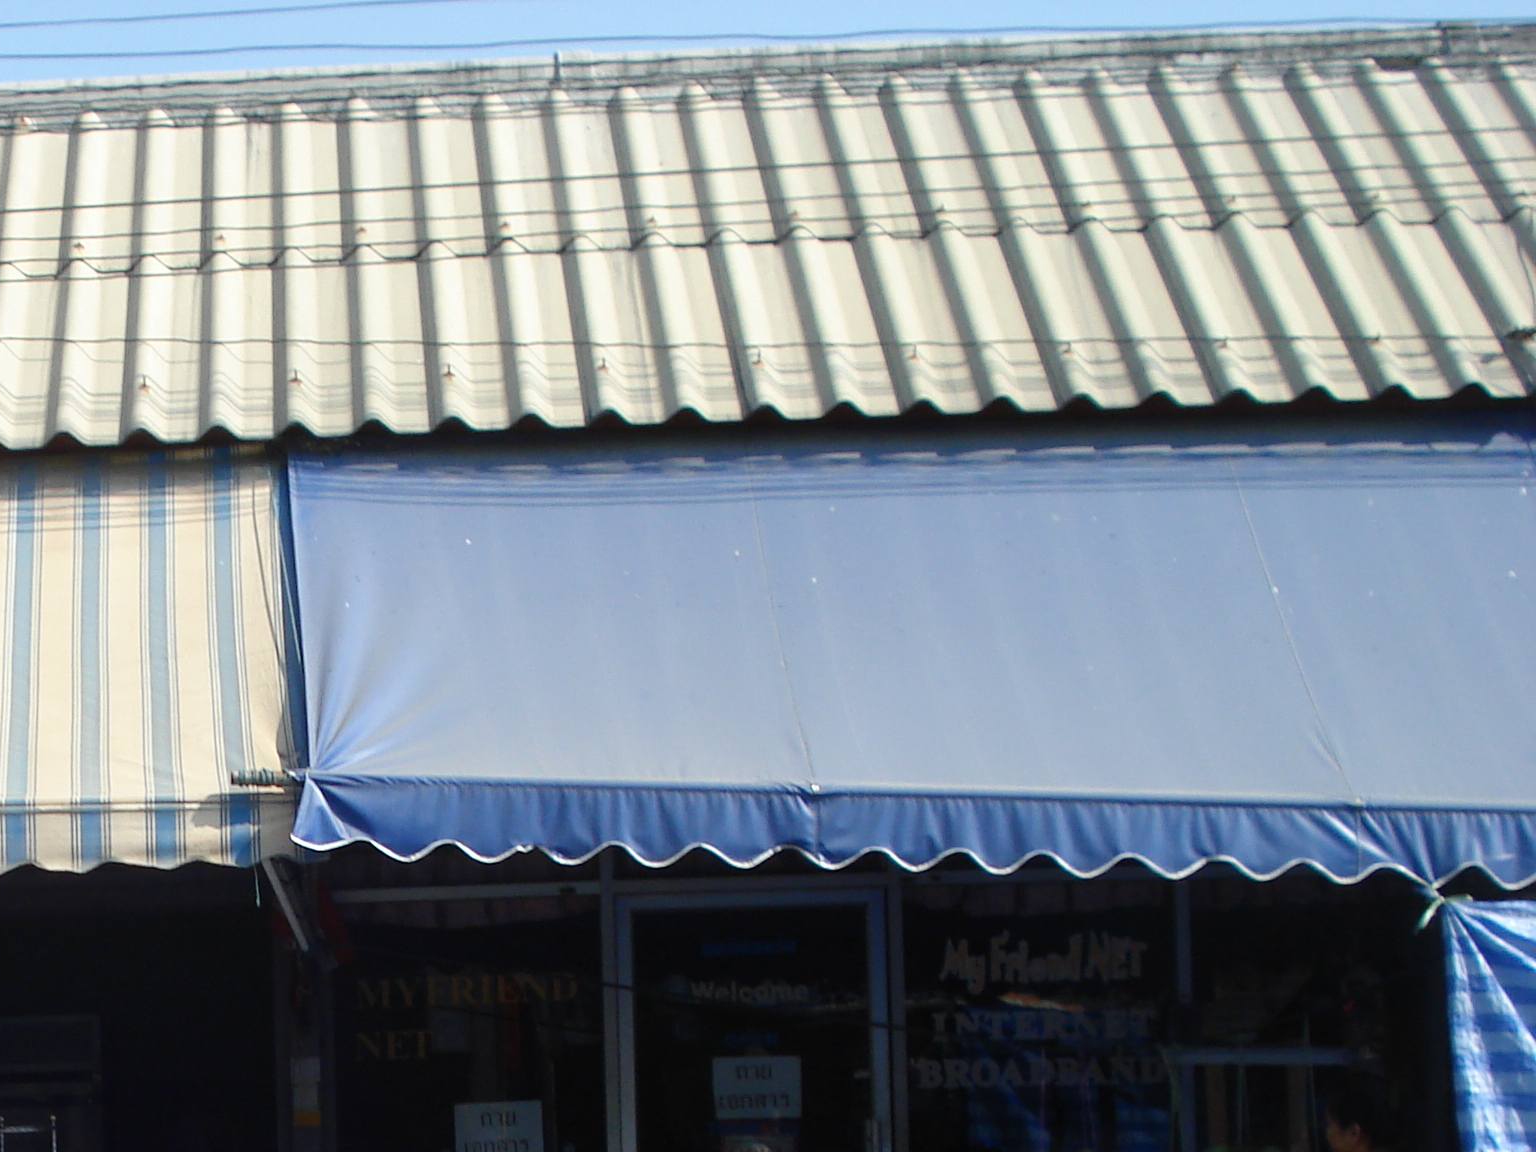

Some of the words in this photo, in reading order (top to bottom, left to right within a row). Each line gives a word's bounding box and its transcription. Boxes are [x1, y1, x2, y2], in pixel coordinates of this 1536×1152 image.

[690, 979, 810, 1004] Welcome
[930, 1008, 1157, 1042] INTERNET
[356, 1030, 430, 1060] NET
